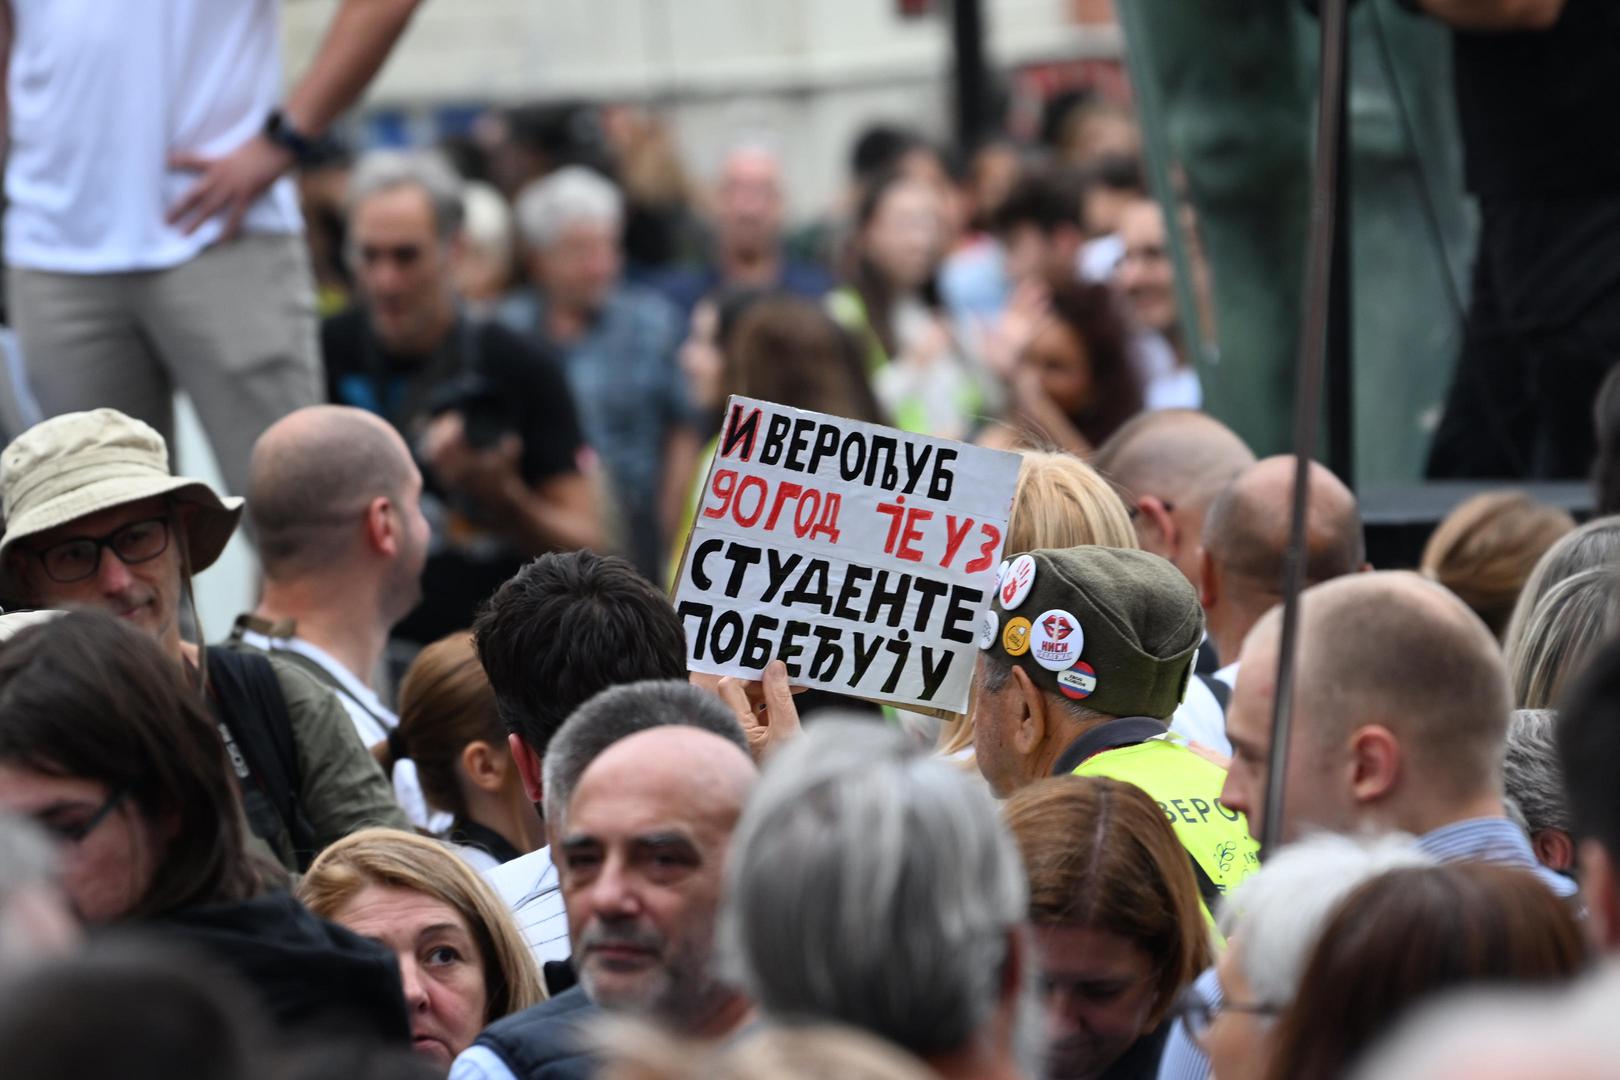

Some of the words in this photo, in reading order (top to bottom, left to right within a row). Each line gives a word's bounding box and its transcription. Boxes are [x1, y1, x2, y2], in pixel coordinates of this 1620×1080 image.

[721, 404, 763, 462] И
[759, 413, 958, 502] ВЕРОЉУБ
[691, 539, 983, 644] СТУДЕНТЕ
[939, 514, 1002, 574] УЗ
